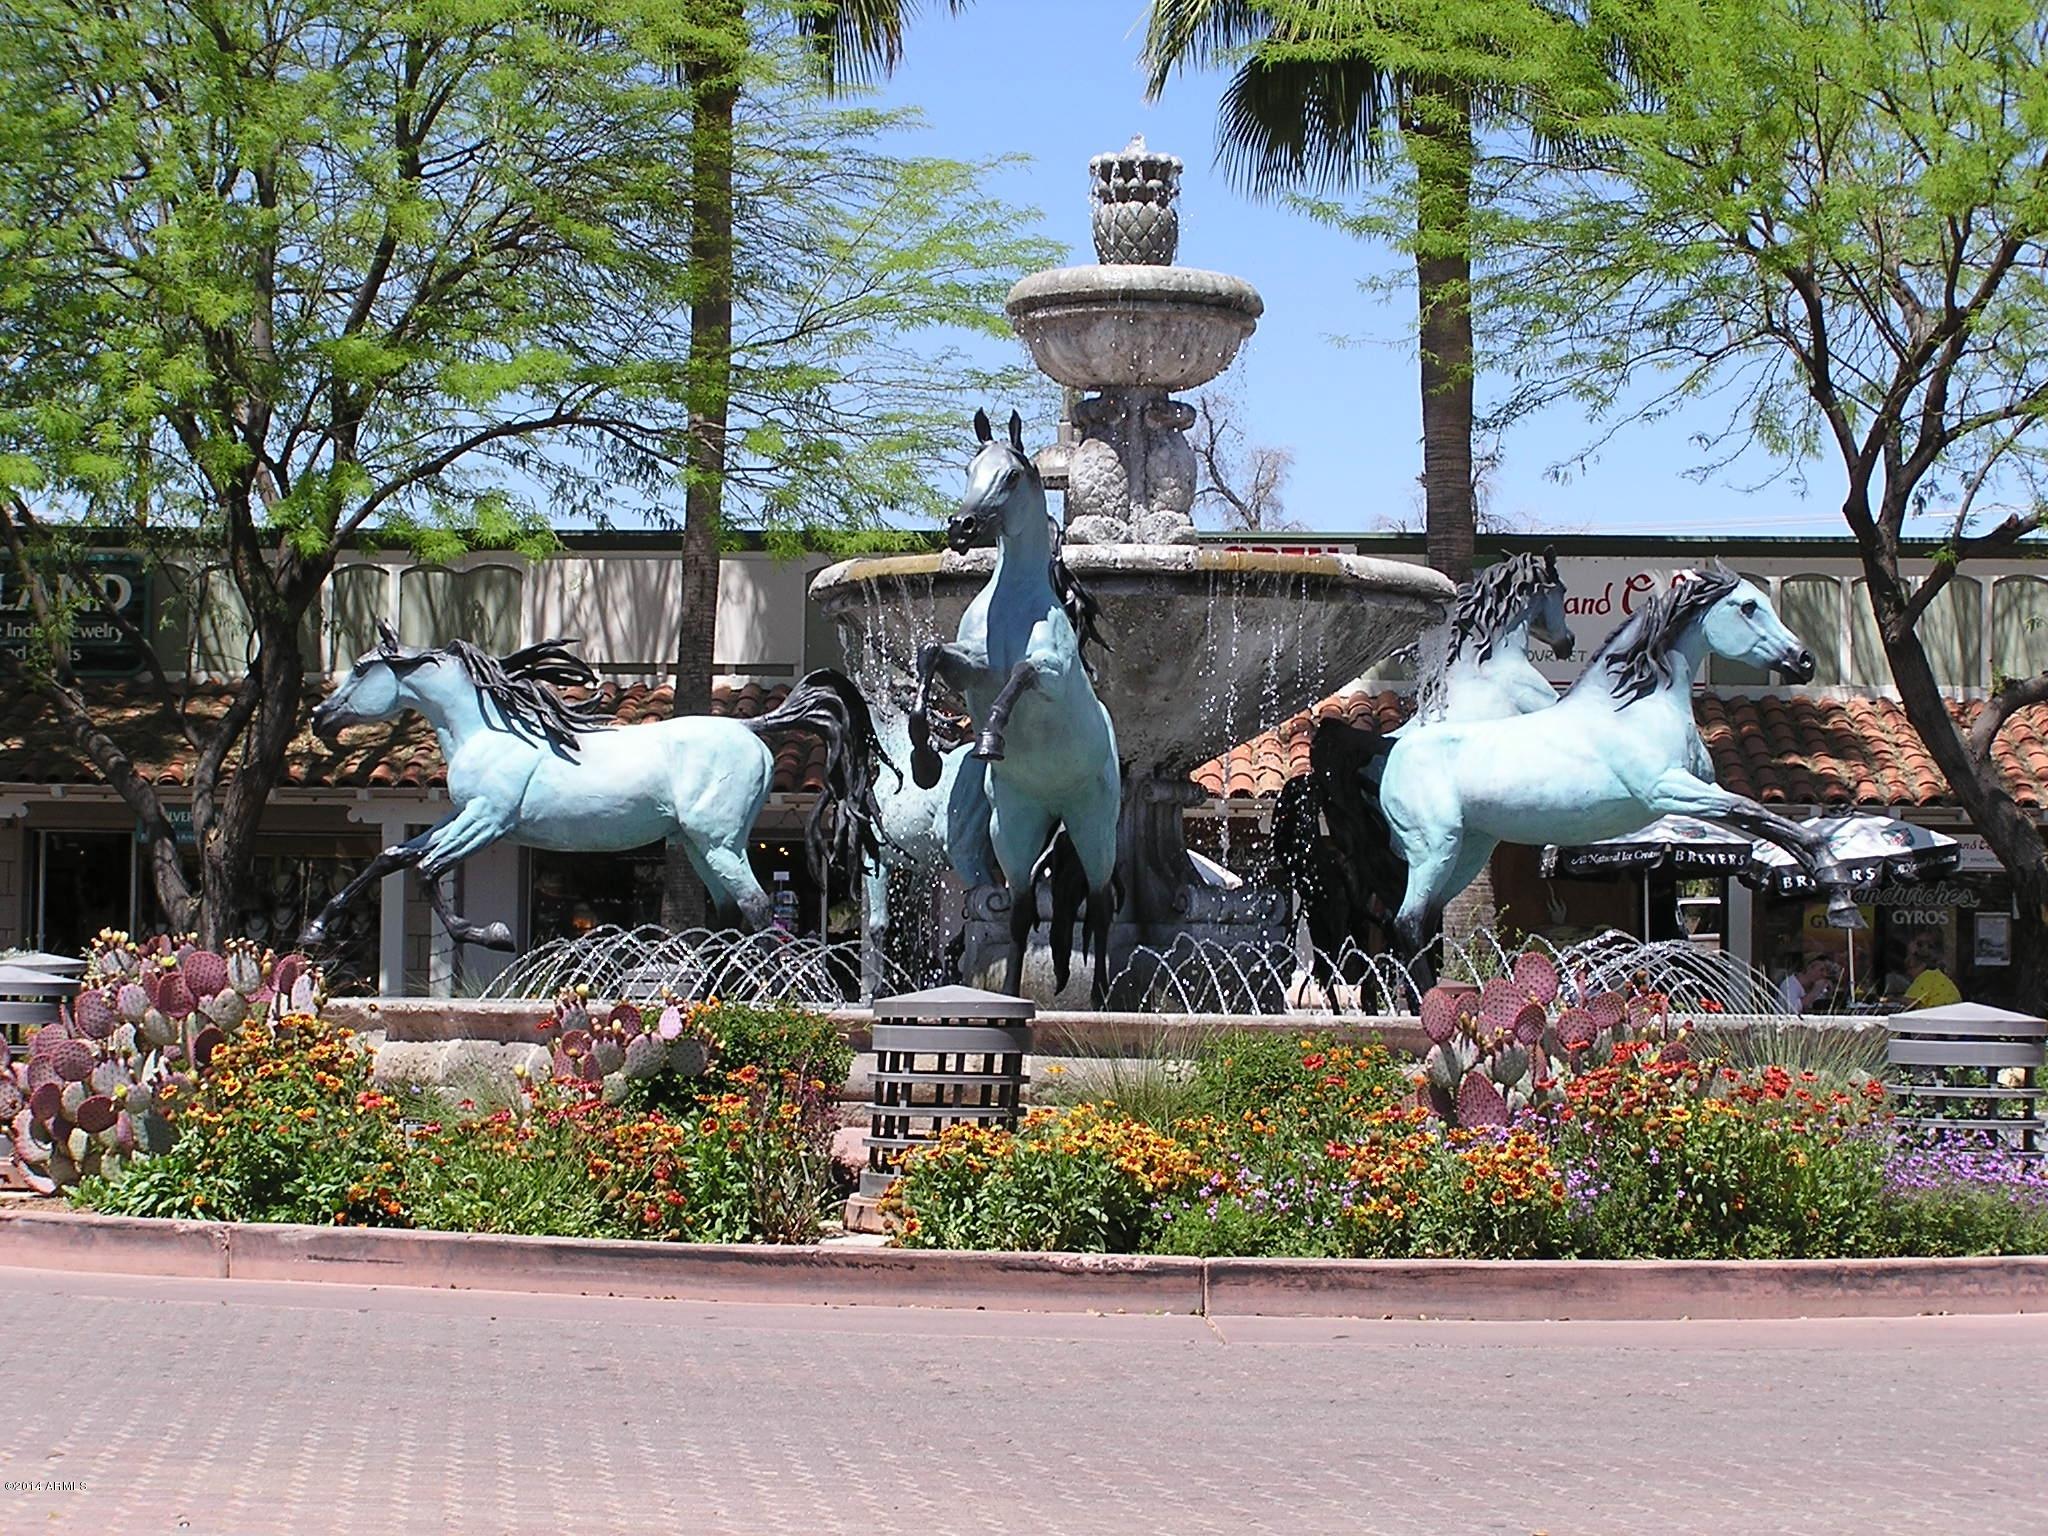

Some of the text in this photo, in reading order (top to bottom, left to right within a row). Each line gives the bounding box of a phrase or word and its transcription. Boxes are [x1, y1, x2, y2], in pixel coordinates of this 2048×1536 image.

[1563, 582, 1613, 615] and
[64, 622, 124, 643] ewelry
[1674, 848, 1747, 867] BREYERS
[1782, 867, 1876, 890] BRRS
[1851, 880, 1980, 908] andwiches
[1891, 909, 1949, 925] GYROS
